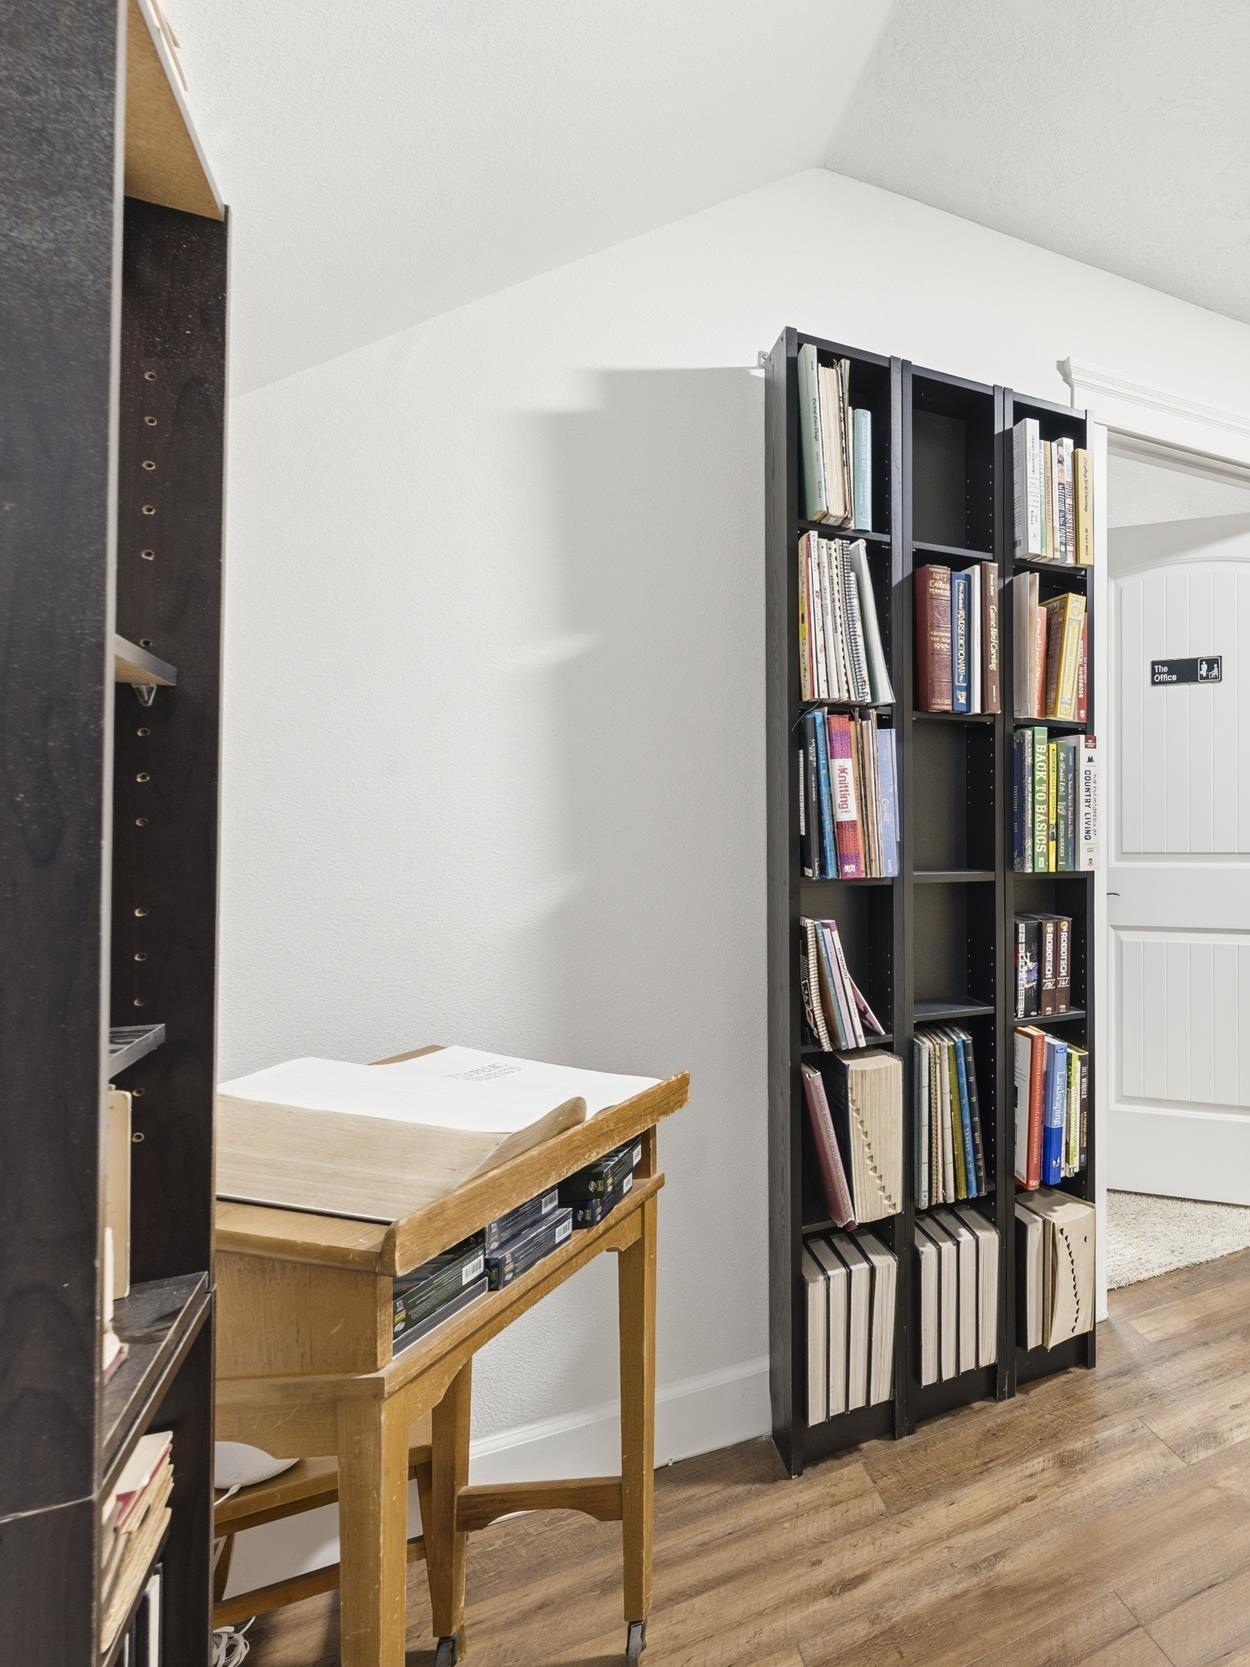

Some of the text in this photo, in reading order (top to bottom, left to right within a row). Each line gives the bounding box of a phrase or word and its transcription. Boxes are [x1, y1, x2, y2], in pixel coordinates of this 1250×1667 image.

[957, 636, 966, 673] DICTIONARY
[989, 605, 998, 671] Game Bird Carving
[1154, 665, 1168, 673] The
[1154, 674, 1177, 682] Office
[838, 767, 850, 809] Knitting
[1036, 745, 1047, 853] BACK TO BASICS
[1045, 933, 1053, 978] ROBOTECH
[1060, 932, 1068, 976] ROBOTECH
[1054, 1071, 1065, 1126] Landscaping
